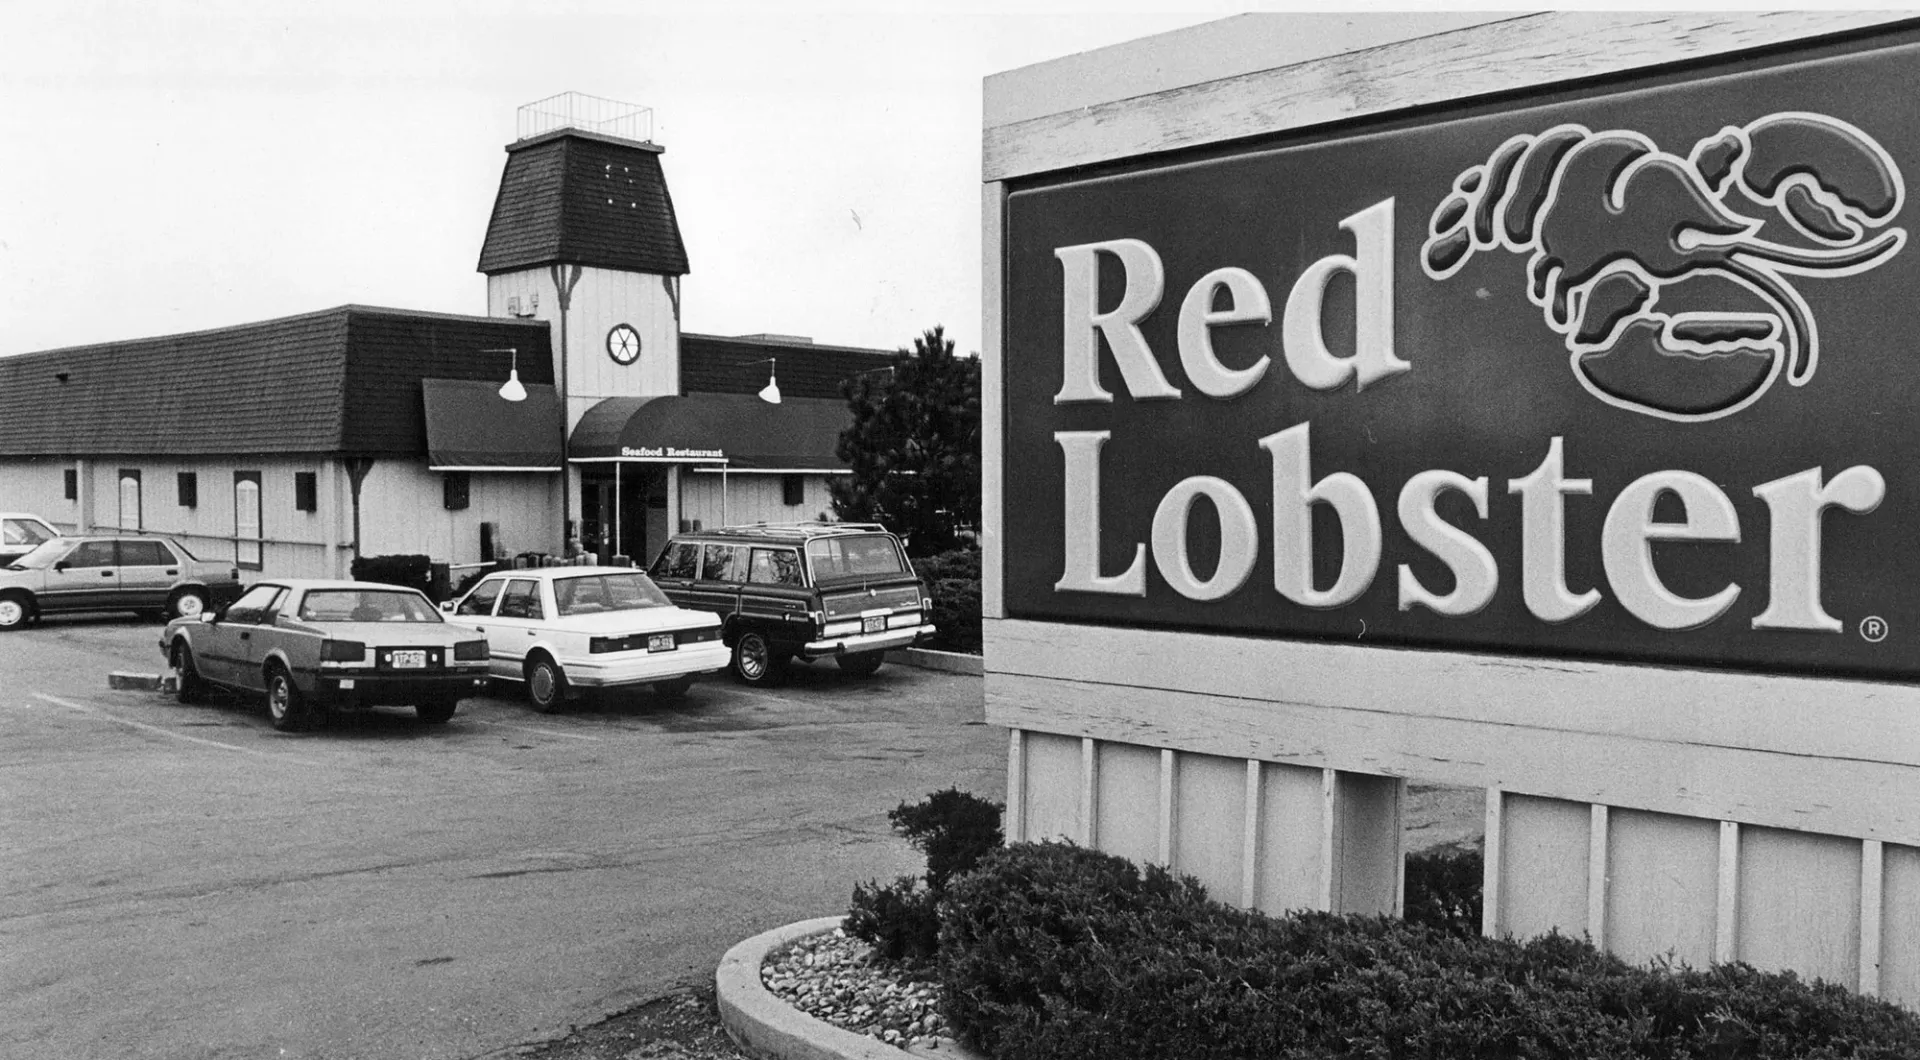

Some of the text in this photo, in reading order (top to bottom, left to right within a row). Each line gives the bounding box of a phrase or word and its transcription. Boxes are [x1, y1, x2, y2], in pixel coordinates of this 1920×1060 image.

[1054, 196, 1411, 404] Red
[621, 446, 723, 457] Seafood Restaurant
[1054, 421, 1886, 634] Lobster
